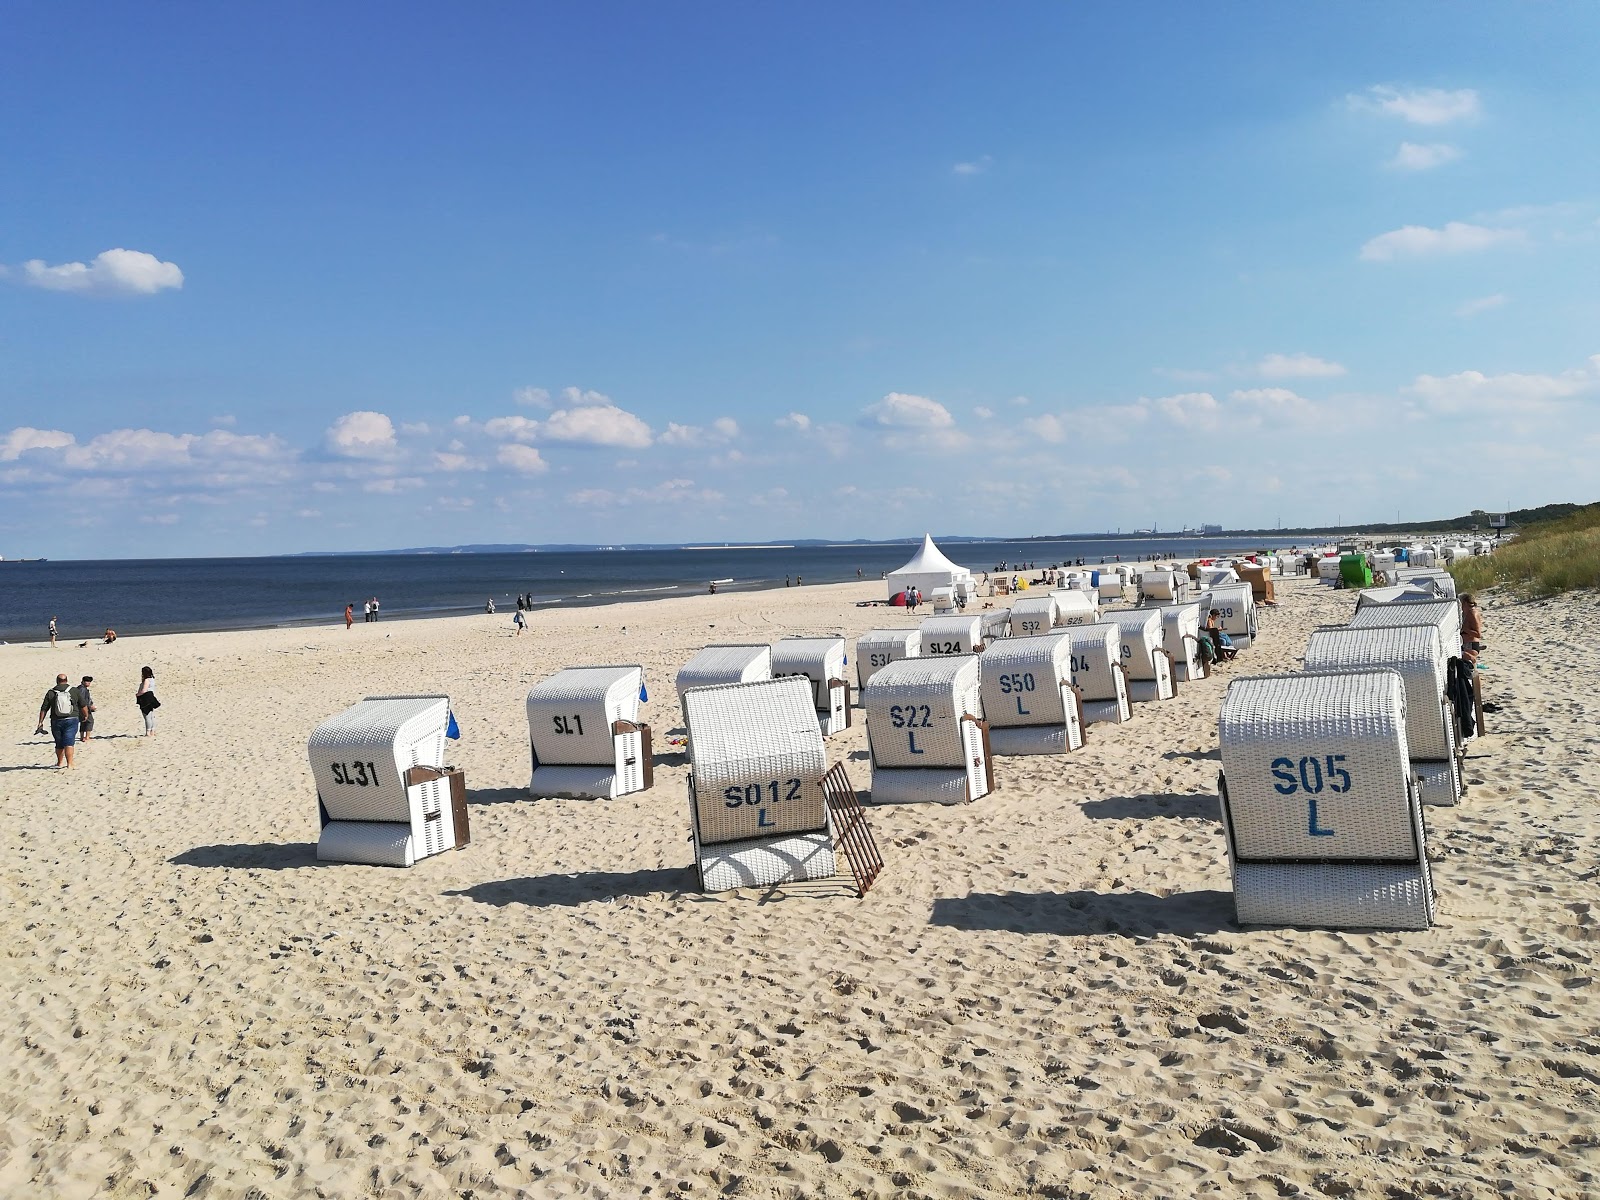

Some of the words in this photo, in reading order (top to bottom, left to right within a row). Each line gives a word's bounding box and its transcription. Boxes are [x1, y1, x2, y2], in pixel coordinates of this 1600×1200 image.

[1022, 621, 1041, 631] S32
[1067, 617, 1083, 625] S25
[930, 641, 961, 654] SL24
[1071, 655, 1090, 671] 04
[1000, 673, 1035, 693] S50
[1017, 696, 1030, 714] L
[553, 714, 584, 735] SL1
[890, 705, 933, 728] S22
[909, 731, 924, 753] L
[331, 760, 380, 787] SL31
[1271, 755, 1351, 795] S05
[758, 809, 775, 827] L
[1309, 800, 1335, 836] L
